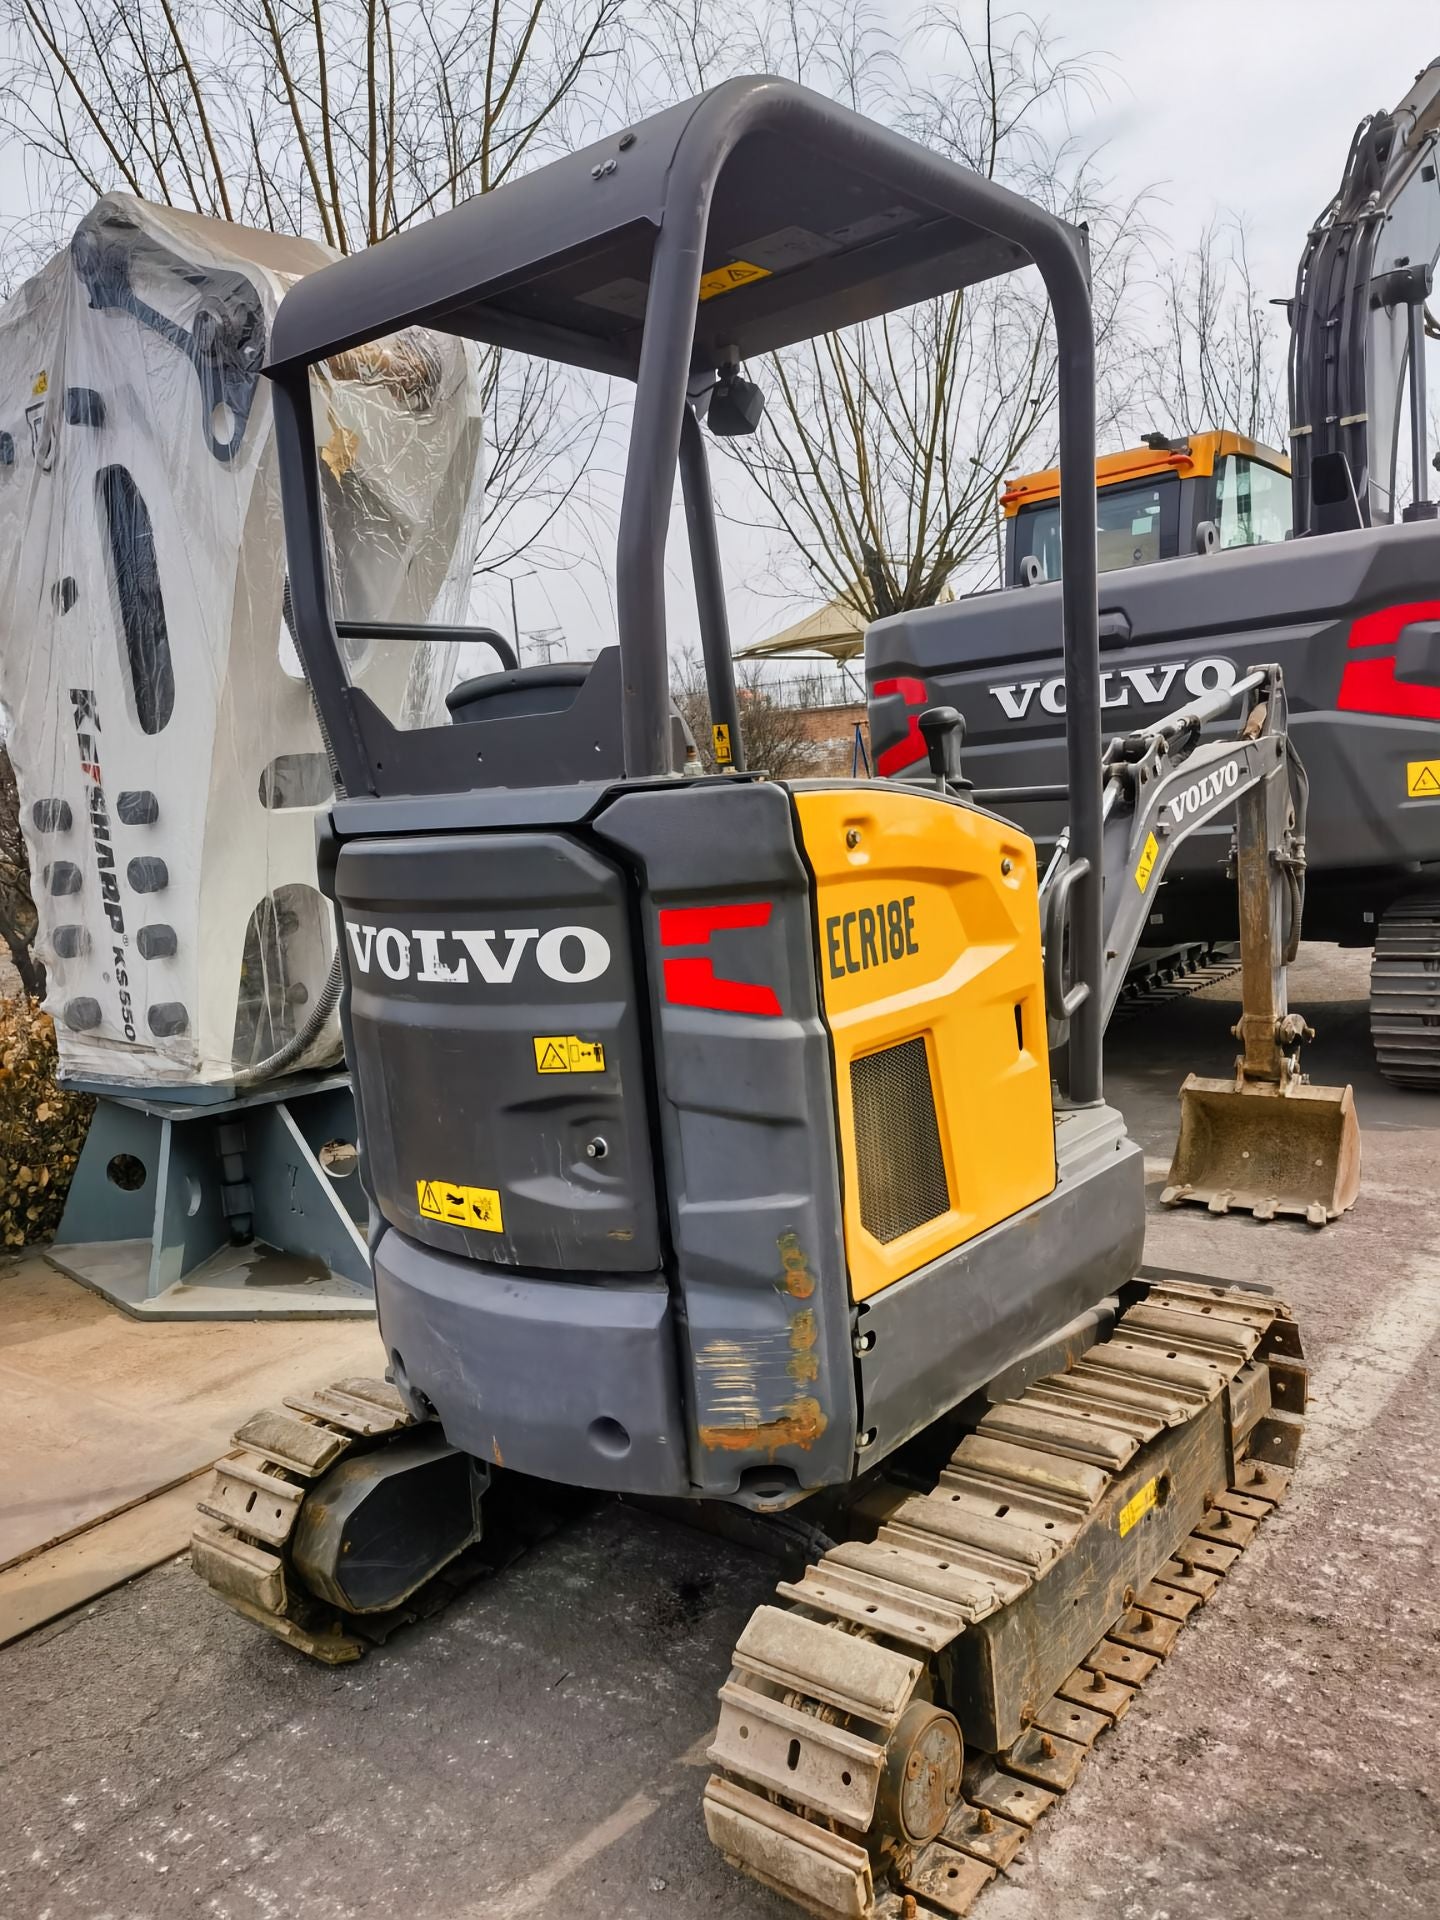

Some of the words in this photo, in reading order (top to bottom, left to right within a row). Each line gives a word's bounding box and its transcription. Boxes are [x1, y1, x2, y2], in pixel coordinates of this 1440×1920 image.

[989, 658, 1237, 719] VOLVO
[1167, 760, 1239, 822] VOLVO
[345, 921, 611, 983] VOLVO
[826, 895, 919, 979] ECR18E
[112, 945, 136, 1042] KS550
